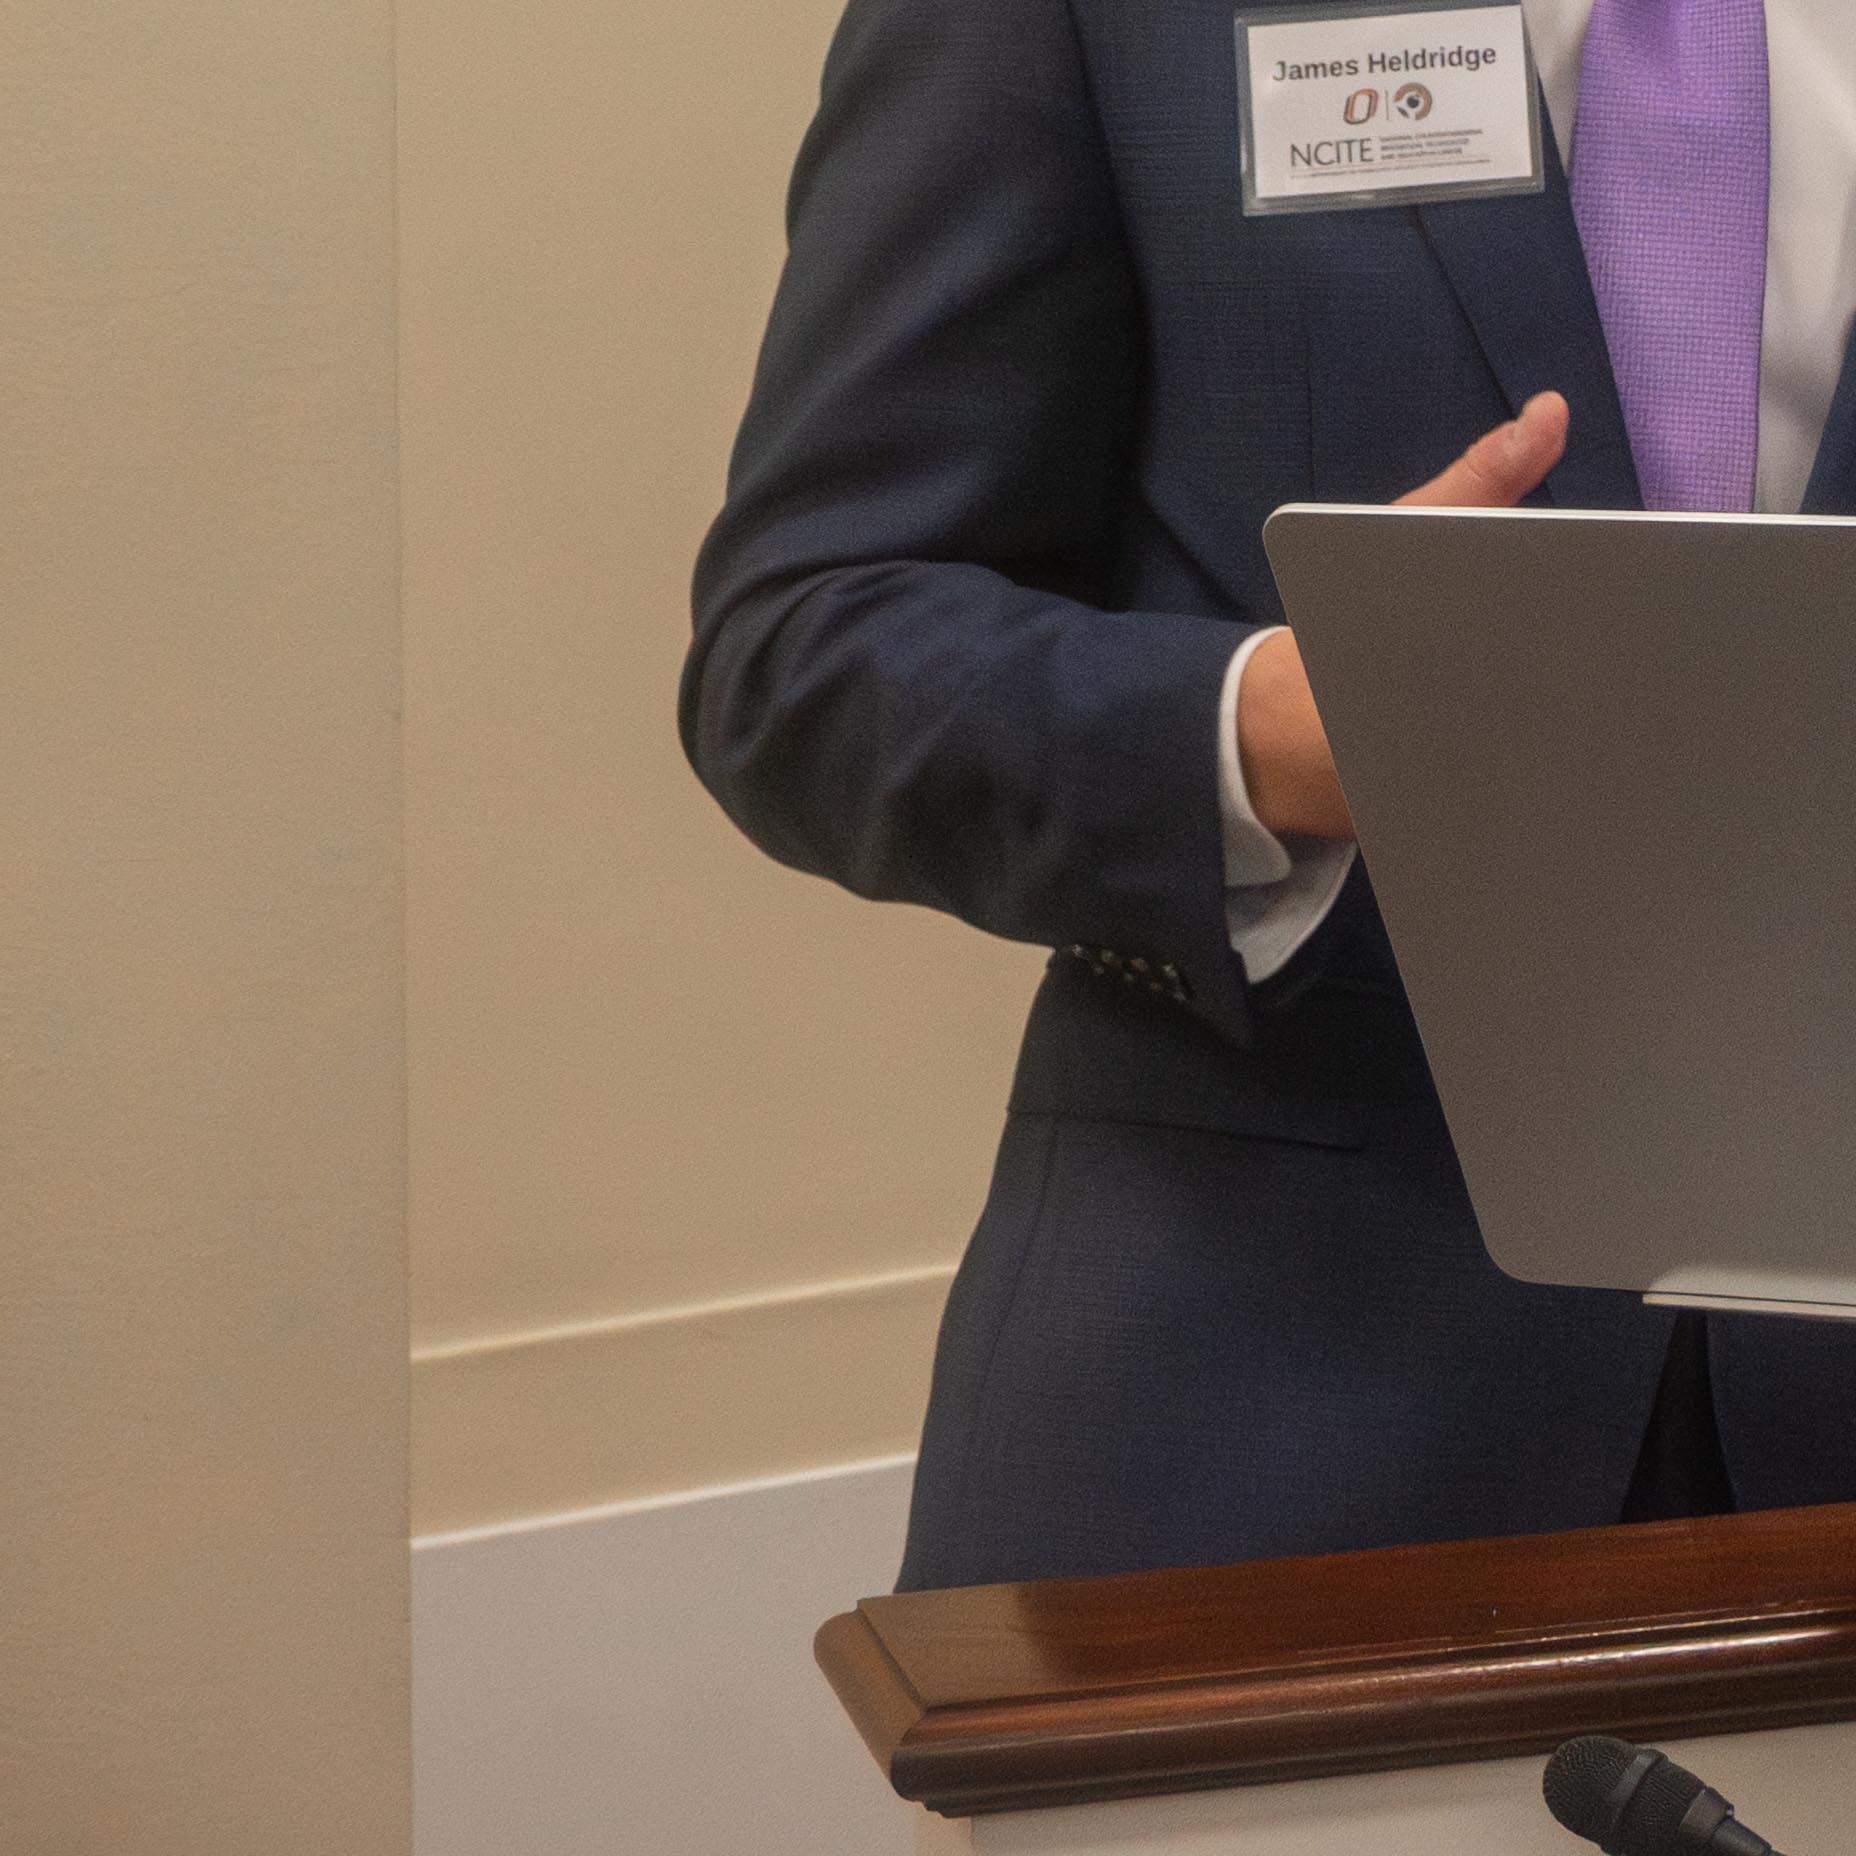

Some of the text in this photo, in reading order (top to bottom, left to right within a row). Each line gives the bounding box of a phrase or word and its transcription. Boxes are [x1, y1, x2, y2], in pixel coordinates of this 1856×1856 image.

[1273, 45, 1497, 81] James Heldridge
[1290, 138, 1373, 168] NCITE
